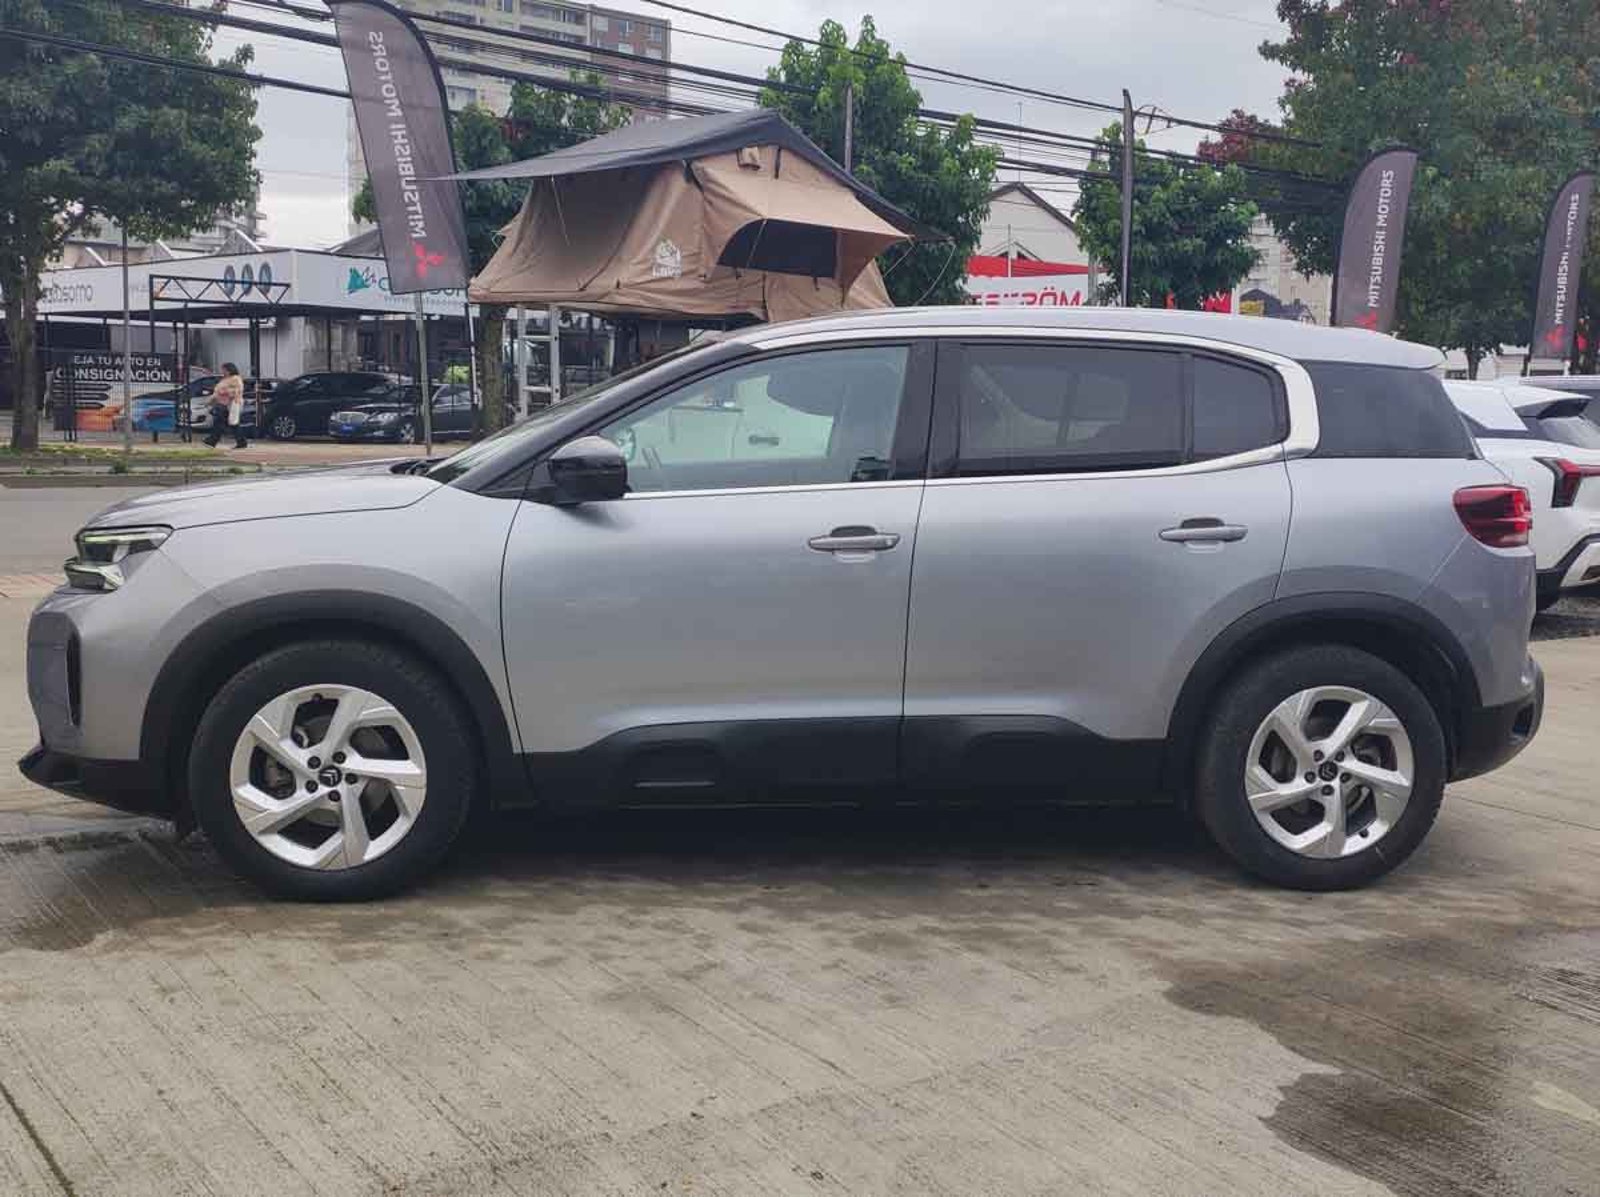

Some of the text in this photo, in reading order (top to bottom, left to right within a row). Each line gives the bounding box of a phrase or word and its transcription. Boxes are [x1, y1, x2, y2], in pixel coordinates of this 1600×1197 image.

[1367, 169, 1395, 308] MITSUBISHI MOTORS
[115, 356, 145, 366] ATO
[56, 367, 172, 382] CNSIGNACIÓN
